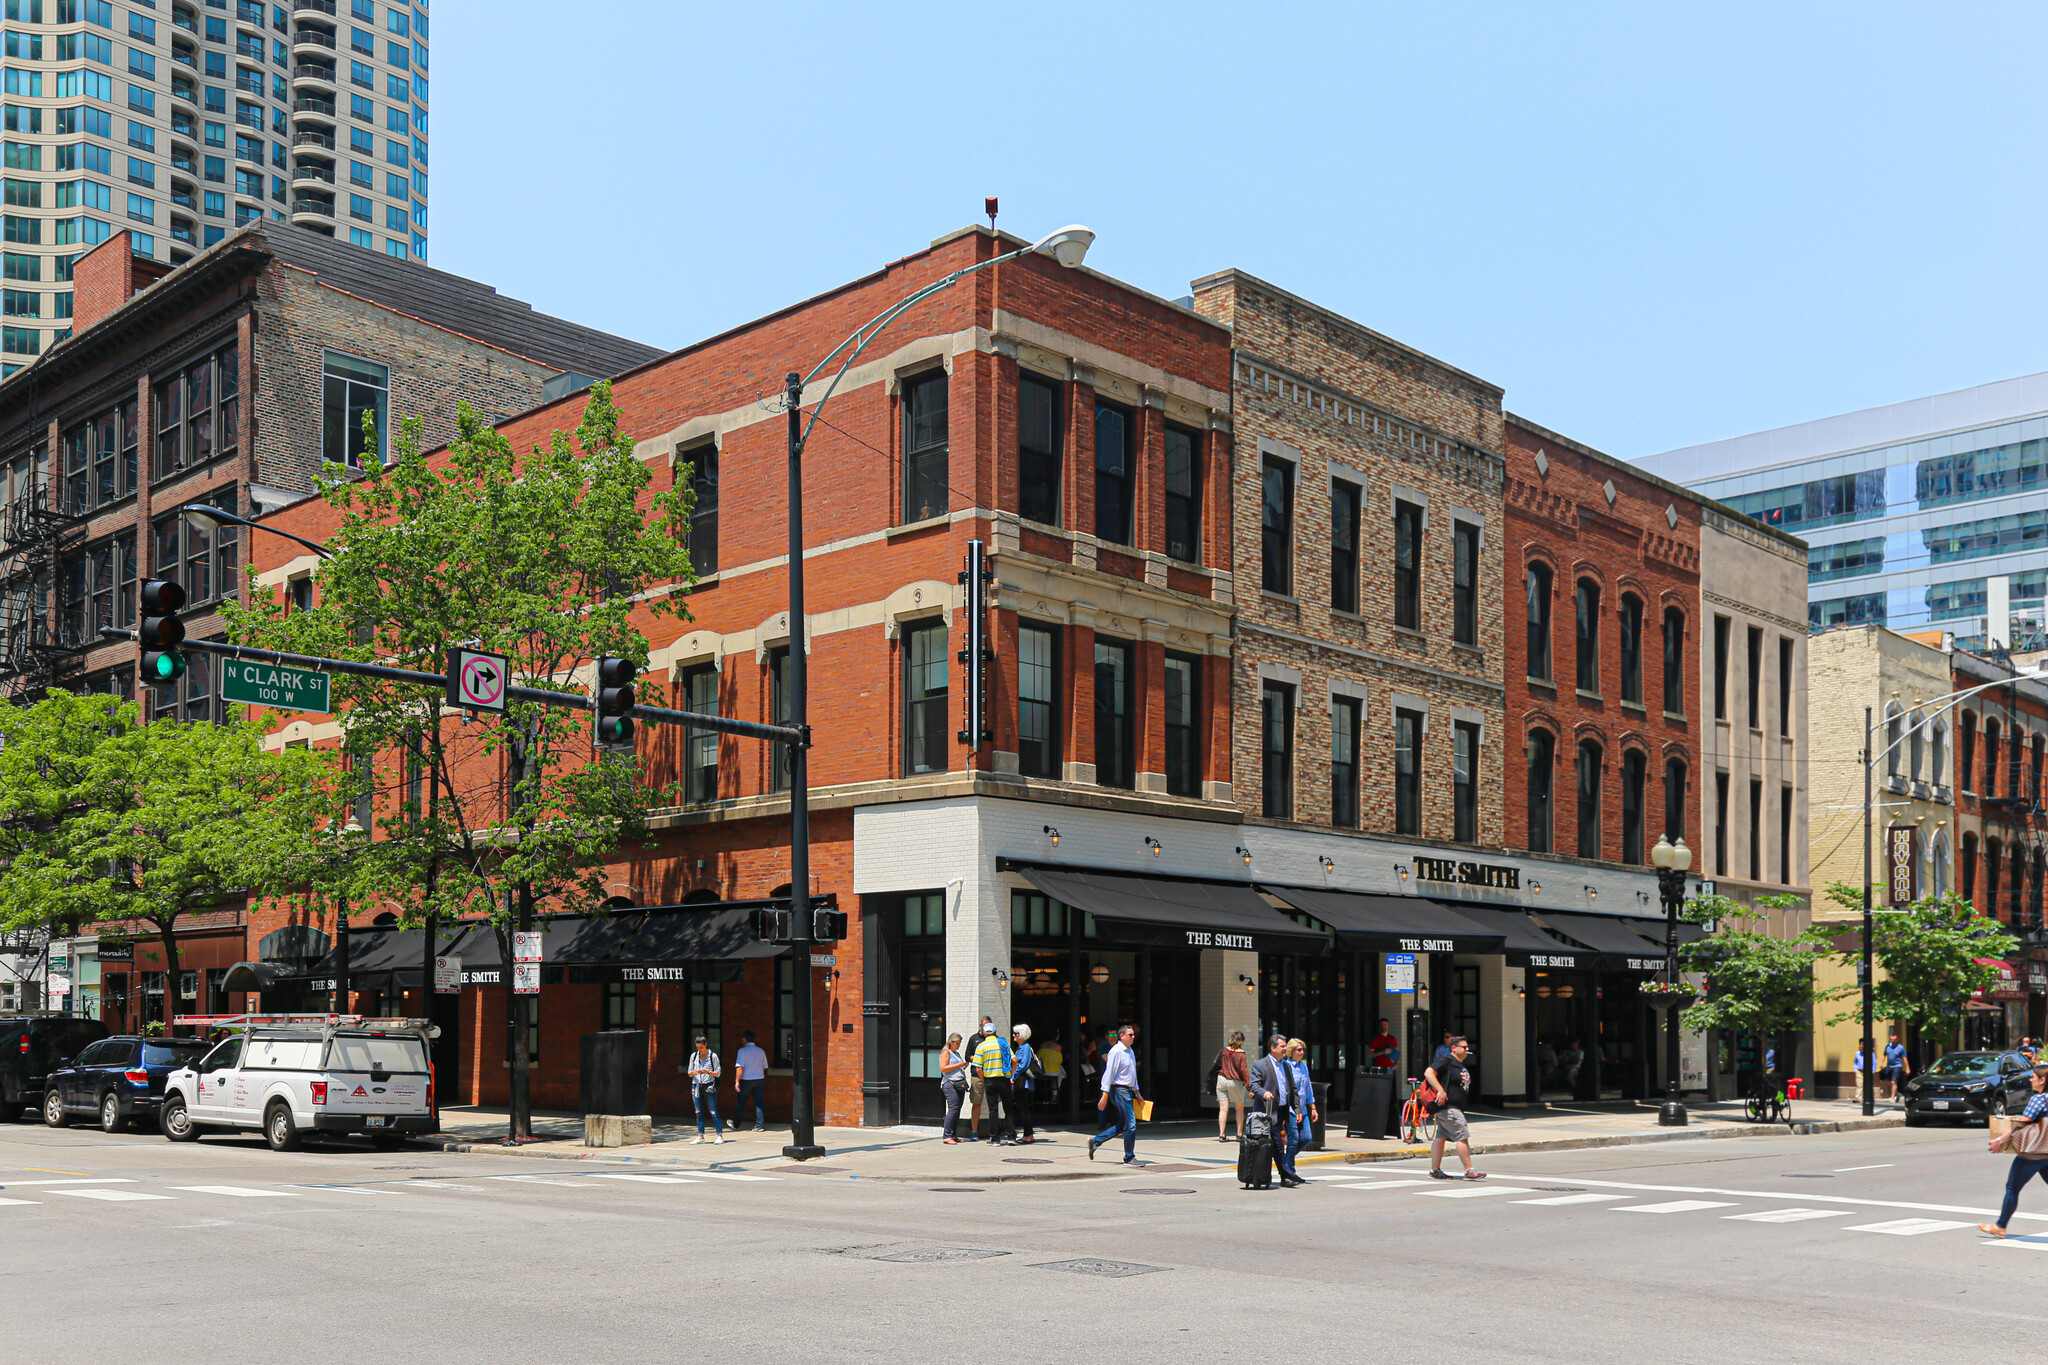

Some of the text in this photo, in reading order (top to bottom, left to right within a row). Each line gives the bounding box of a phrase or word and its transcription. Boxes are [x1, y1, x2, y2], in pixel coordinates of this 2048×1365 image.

[228, 666, 322, 690] N CLARK ST
[259, 688, 294, 702] 100 W
[1413, 856, 1520, 889] THE SMITH
[1893, 830, 1910, 902] HAVANA
[1186, 931, 1253, 949] THE SMITH
[1399, 939, 1454, 952] THE SMITH
[1530, 955, 1575, 968] THE SMITH
[1627, 959, 1665, 970] THE SMITH
[471, 971, 500, 983] SMITH
[622, 968, 684, 980] THE SMITH
[311, 980, 326, 991] THE
